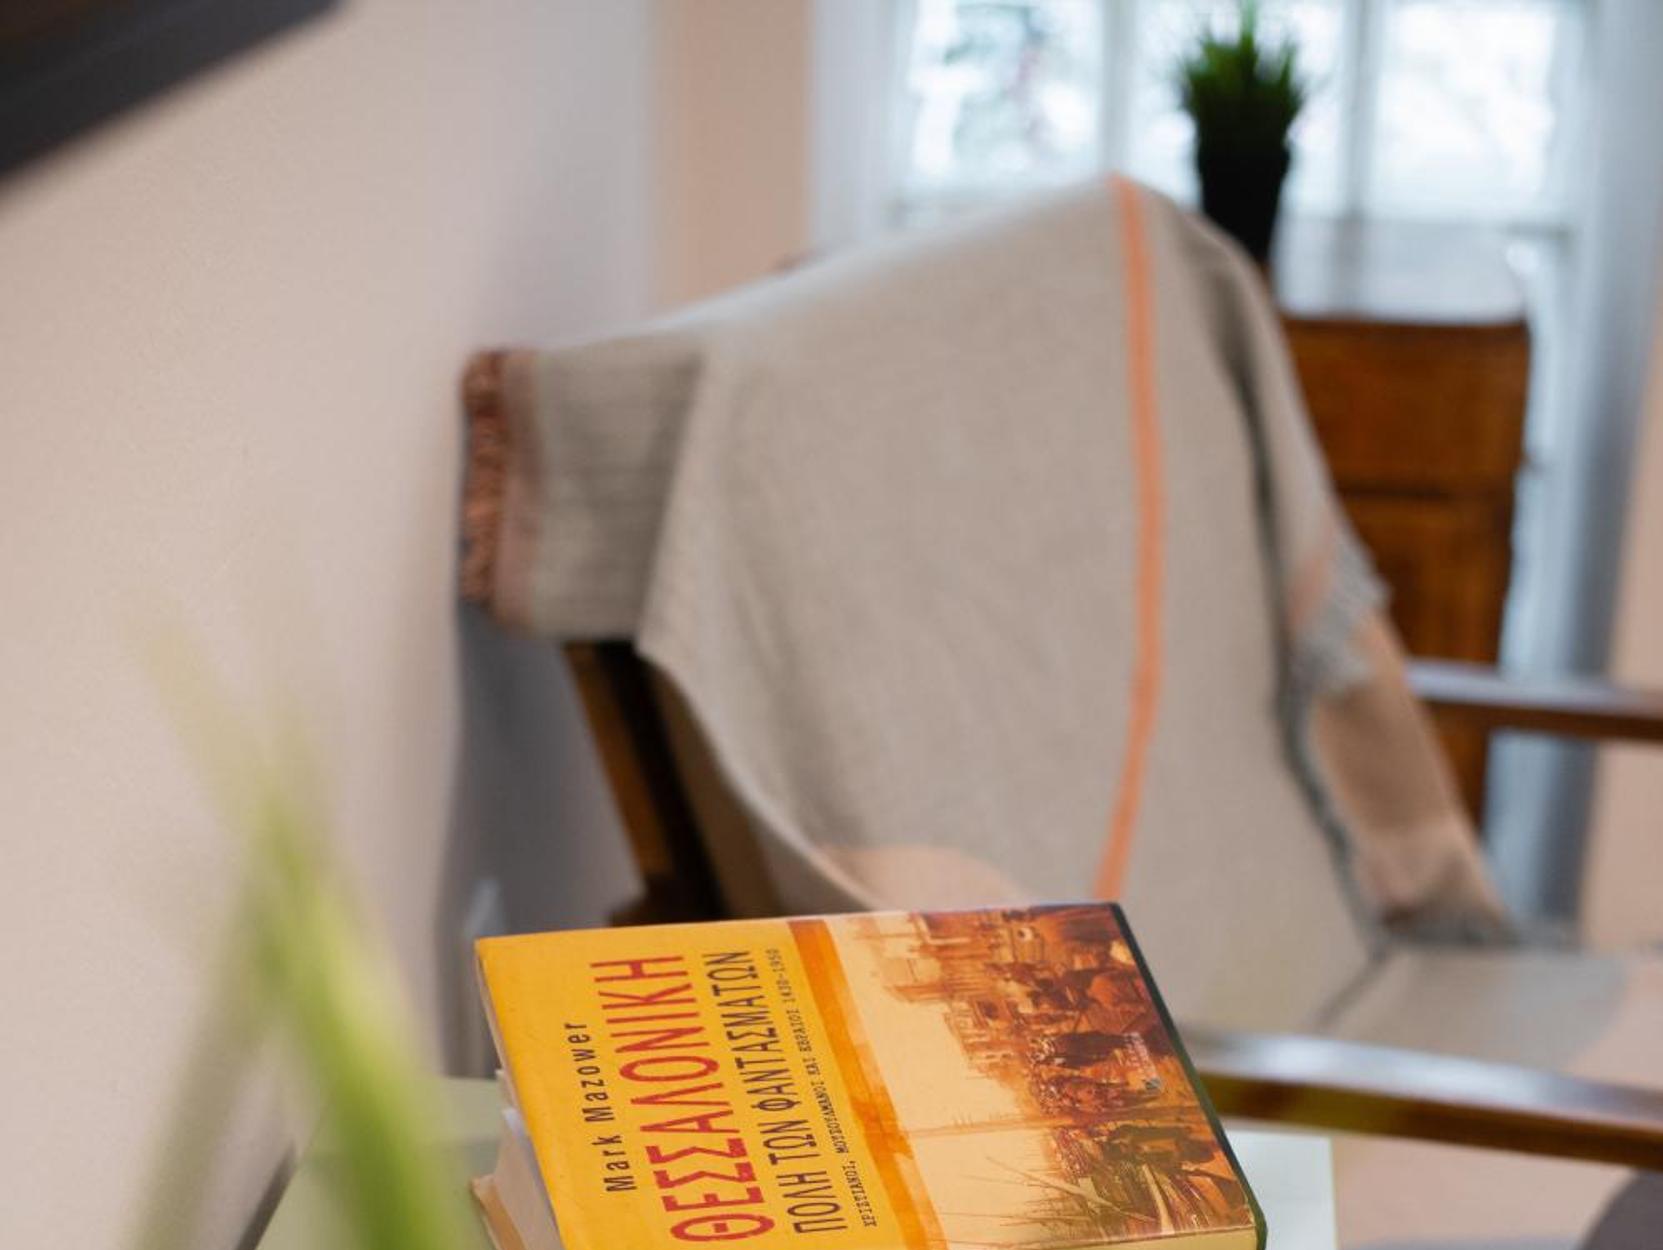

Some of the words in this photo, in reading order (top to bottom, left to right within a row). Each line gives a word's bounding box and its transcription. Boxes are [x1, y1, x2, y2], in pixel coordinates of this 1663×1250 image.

[564, 1022, 616, 1122] Mazower
[701, 950, 802, 1113] ΦΑΝΤΑΣΜΑΤΩΝ
[589, 955, 776, 1242] ΘΕΣΣΑΛΟΝΙΚΗ
[591, 1134, 638, 1192] Mark
[757, 1119, 822, 1166] ΤΩΝ
[775, 1170, 849, 1234] ΠΟΛΗ
